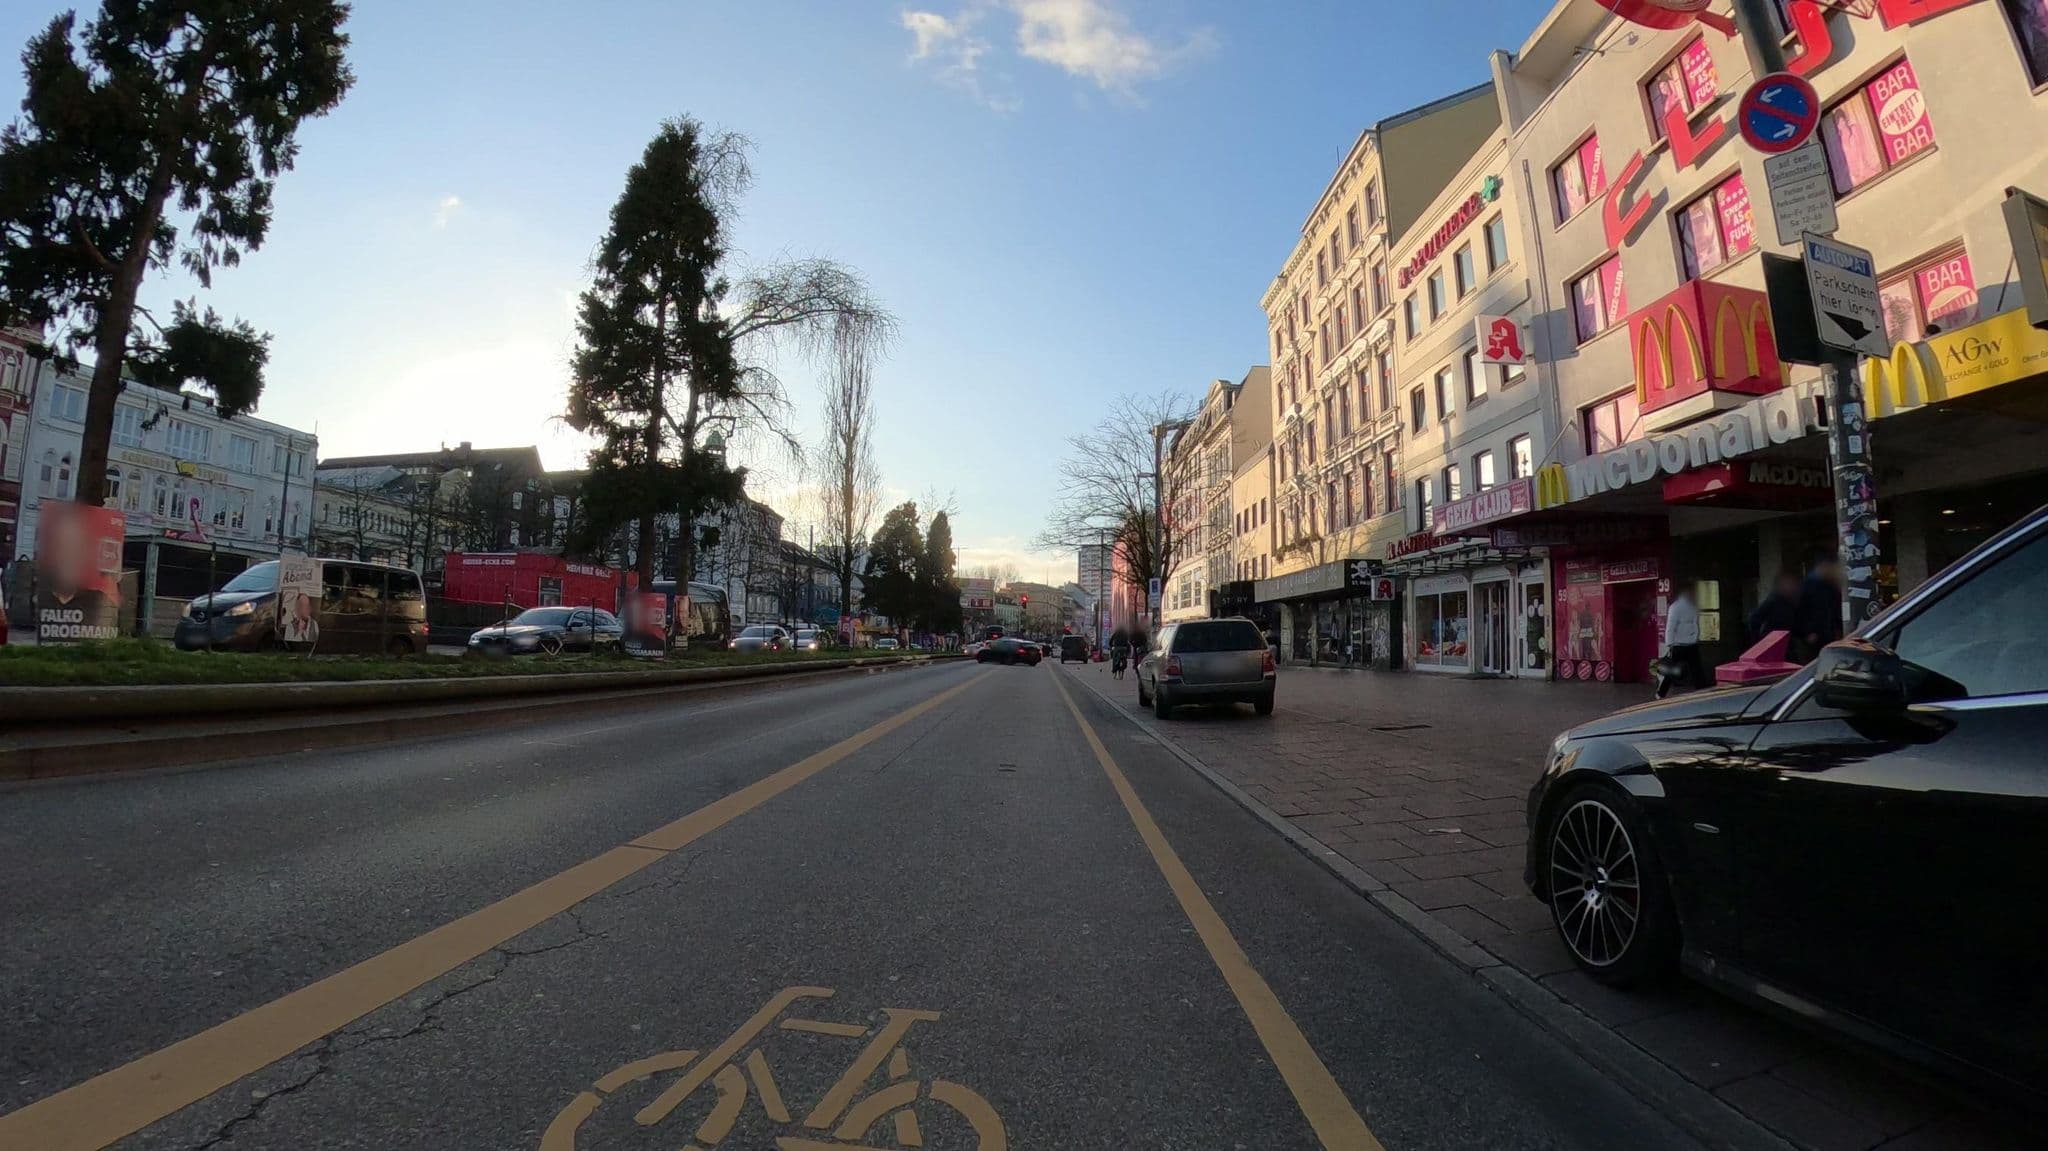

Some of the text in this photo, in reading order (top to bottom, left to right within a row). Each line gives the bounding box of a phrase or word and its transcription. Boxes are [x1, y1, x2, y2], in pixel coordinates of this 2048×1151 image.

[1695, 80, 1716, 101] FUCK
[1697, 70, 1708, 86] AS
[1876, 66, 1911, 101] BAR
[1881, 92, 1919, 130] EINTRITT
[1893, 125, 1930, 160] BAR
[1729, 220, 1753, 243] FUCK
[1732, 209, 1744, 227] AS
[1814, 243, 1867, 275] AUTOMAT
[1814, 270, 1877, 300] Parkschein
[1926, 260, 1966, 294] BAR
[1820, 293, 1842, 309] hier
[1574, 385, 1827, 497] McDonald
[1445, 500, 1473, 528] GEIZ
[1475, 488, 1512, 521] CLUB
[1658, 578, 1671, 593] 59
[40, 608, 83, 623] FALKO
